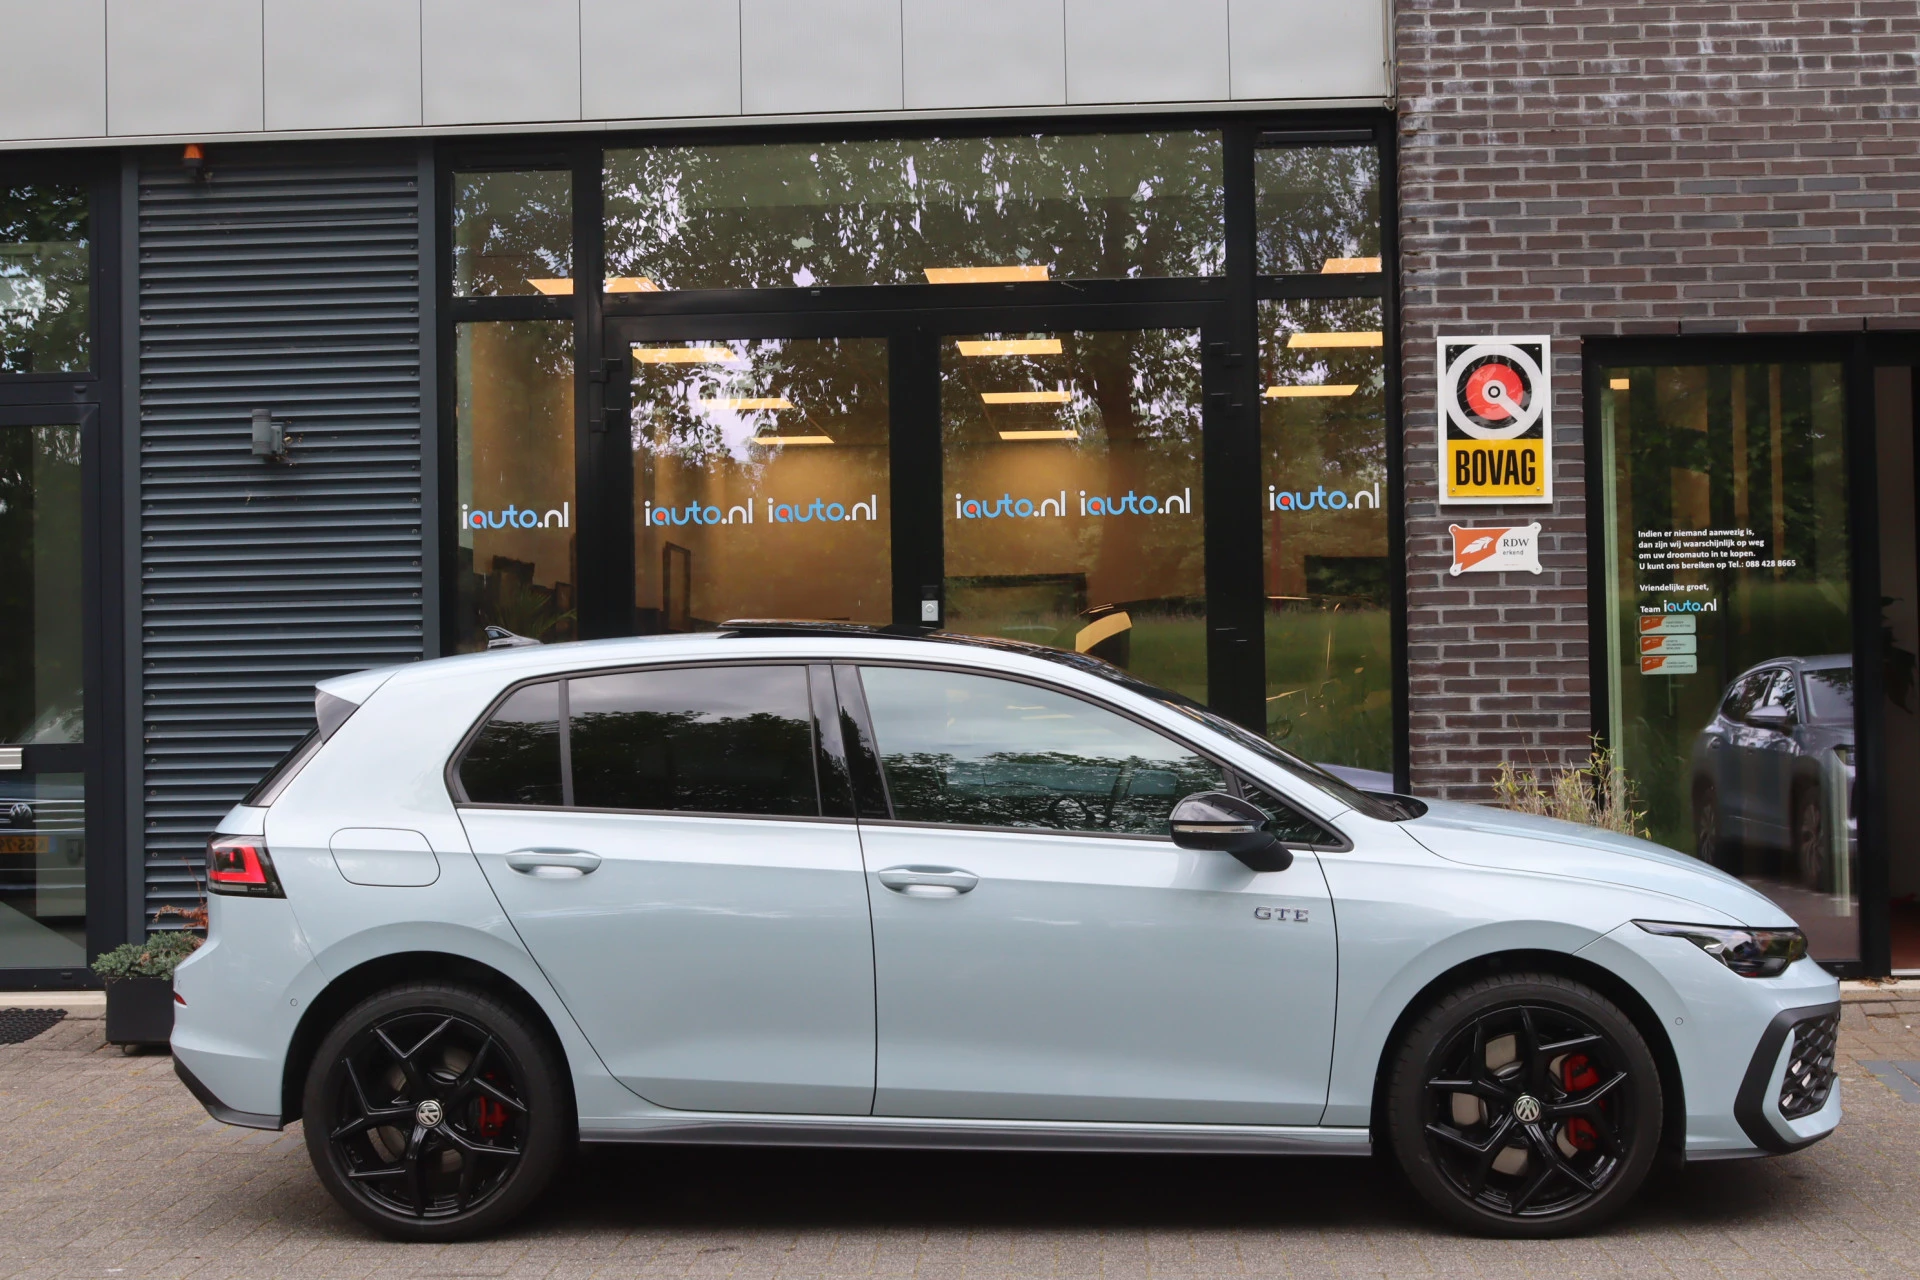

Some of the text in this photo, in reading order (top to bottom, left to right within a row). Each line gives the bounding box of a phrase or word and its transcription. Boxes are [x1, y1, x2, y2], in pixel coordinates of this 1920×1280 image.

[1455, 448, 1536, 486] BOVAG
[956, 488, 1190, 518] iauto.nl iauto.nl
[1269, 483, 1379, 511] iauto.nl
[462, 502, 568, 529] iauto.nl
[645, 495, 876, 526] iauto.nl iauto.nl
[1638, 530, 1662, 538] Indien
[1674, 529, 1707, 537] niemand
[1709, 528, 1745, 537] aanwezig
[1746, 528, 1755, 536] is,
[1503, 538, 1530, 547] RDW
[1638, 541, 1653, 549] dan
[1655, 541, 1668, 549] zijn
[1670, 540, 1681, 549] wij
[1683, 539, 1735, 548] waarschijnlijk
[1666, 551, 1710, 559] droomauto
[1729, 550, 1756, 558] kopen.
[1647, 562, 1665, 570] kunt
[1716, 562, 1727, 570] op
[1745, 560, 1760, 568] 088
[1777, 559, 1796, 567] 8665
[1639, 584, 1709, 592] Vriendelijke groet,
[1640, 598, 1717, 613] Team iauto.nl
[1254, 905, 1309, 922] GTE
